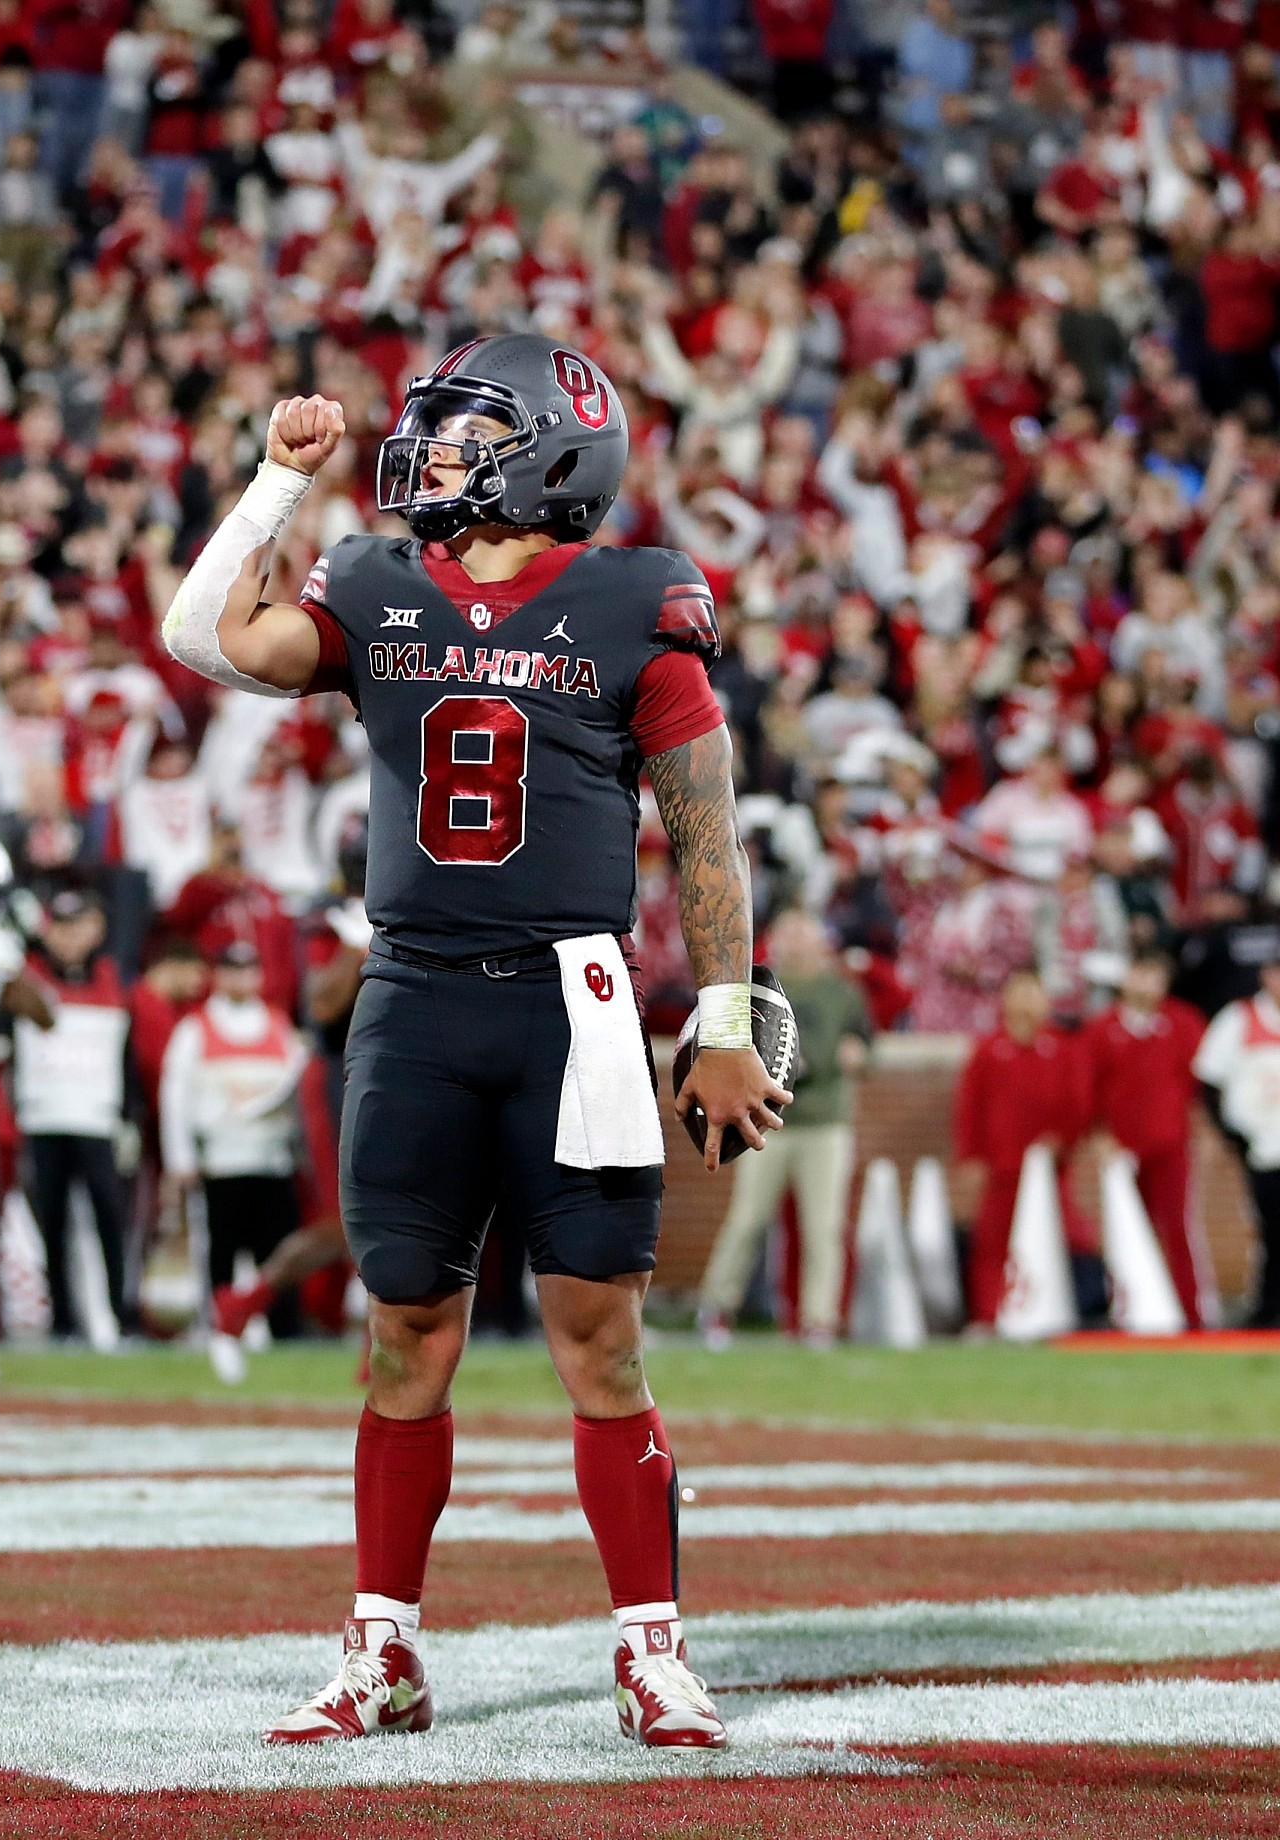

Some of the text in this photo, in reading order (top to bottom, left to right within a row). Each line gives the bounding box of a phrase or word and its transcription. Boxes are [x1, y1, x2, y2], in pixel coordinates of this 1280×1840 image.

[550, 349, 610, 430] OU
[379, 606, 424, 629] XII
[470, 603, 492, 630] OU
[368, 643, 601, 698] OKLAHOMA
[416, 695, 529, 866] 8
[584, 962, 614, 1002] OU
[650, 1627, 667, 1649] OU
